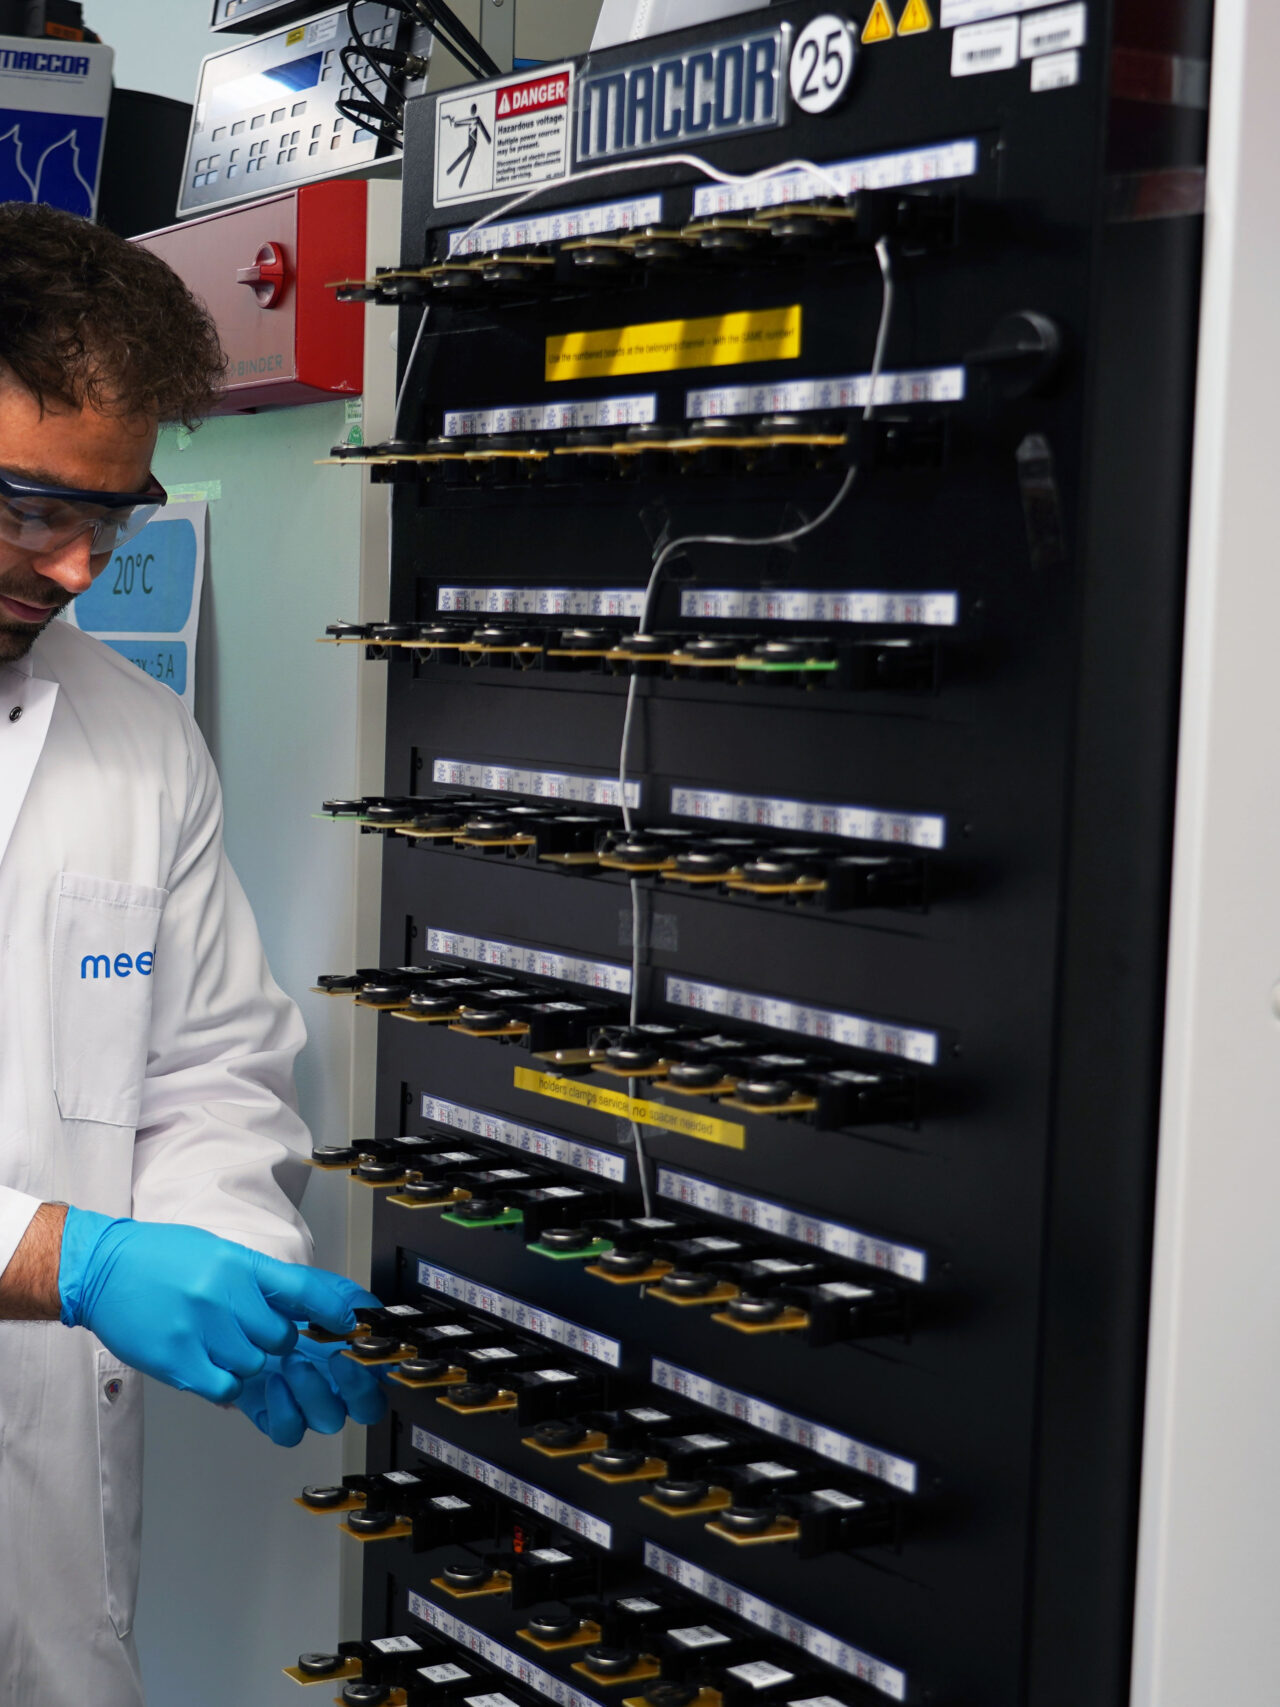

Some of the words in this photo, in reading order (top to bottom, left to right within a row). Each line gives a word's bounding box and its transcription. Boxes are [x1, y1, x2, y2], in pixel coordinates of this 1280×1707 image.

[798, 30, 844, 99] 25
[512, 81, 566, 110] DANGER
[580, 37, 778, 156] MACCOR
[497, 121, 534, 135] Hazardous
[536, 114, 566, 126] voltage.
[237, 355, 283, 376] BINDER
[113, 553, 154, 595] 20°C
[81, 944, 157, 980] mee
[632, 1106, 646, 1118] no
